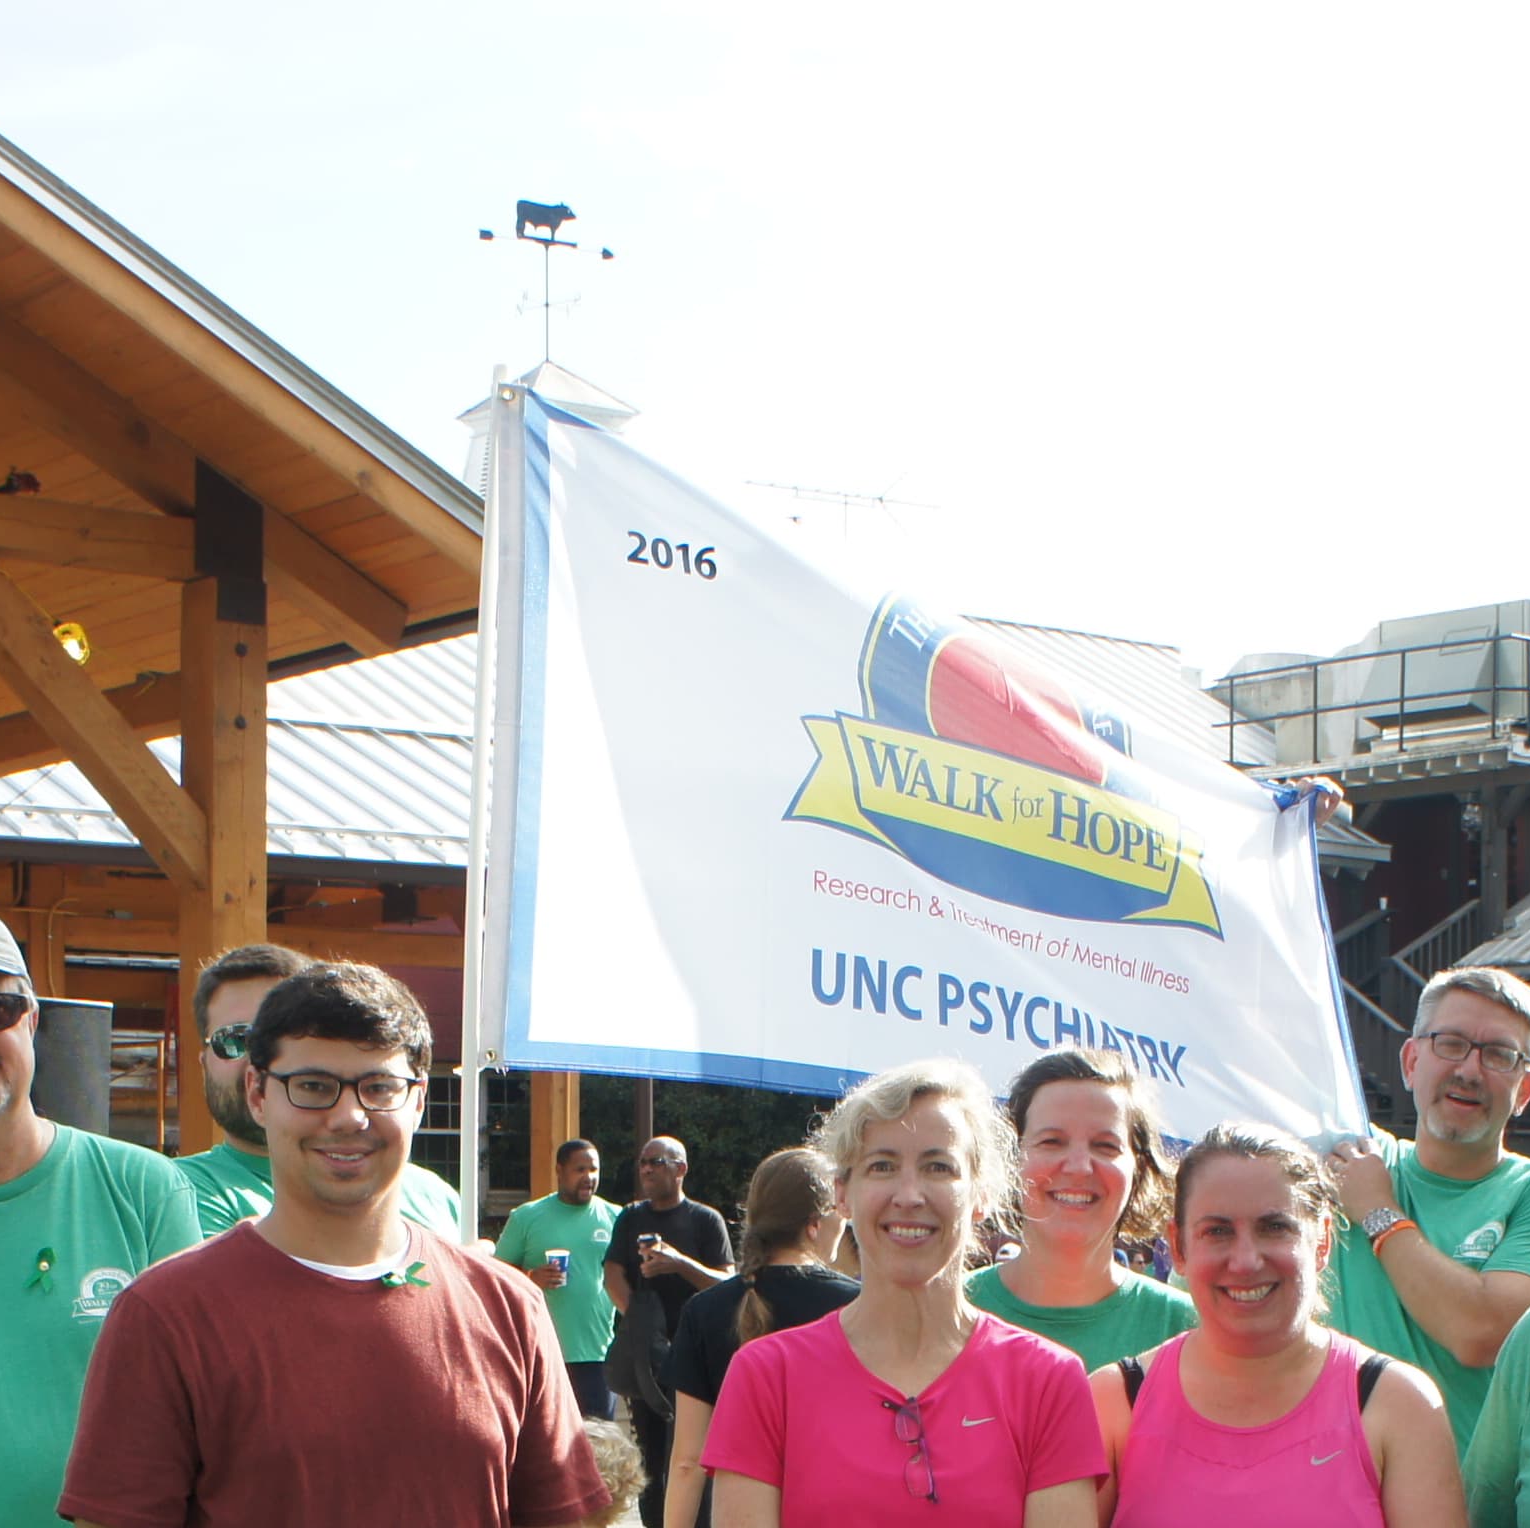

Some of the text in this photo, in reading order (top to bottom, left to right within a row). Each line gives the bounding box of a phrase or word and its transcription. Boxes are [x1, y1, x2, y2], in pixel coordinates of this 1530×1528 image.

[627, 530, 717, 580] 2016
[857, 734, 1169, 872] WALK for HOPE
[813, 870, 1191, 995] Research & Treatment of Mental Illness
[812, 948, 1188, 1088] UNC PSYCHIATRY
